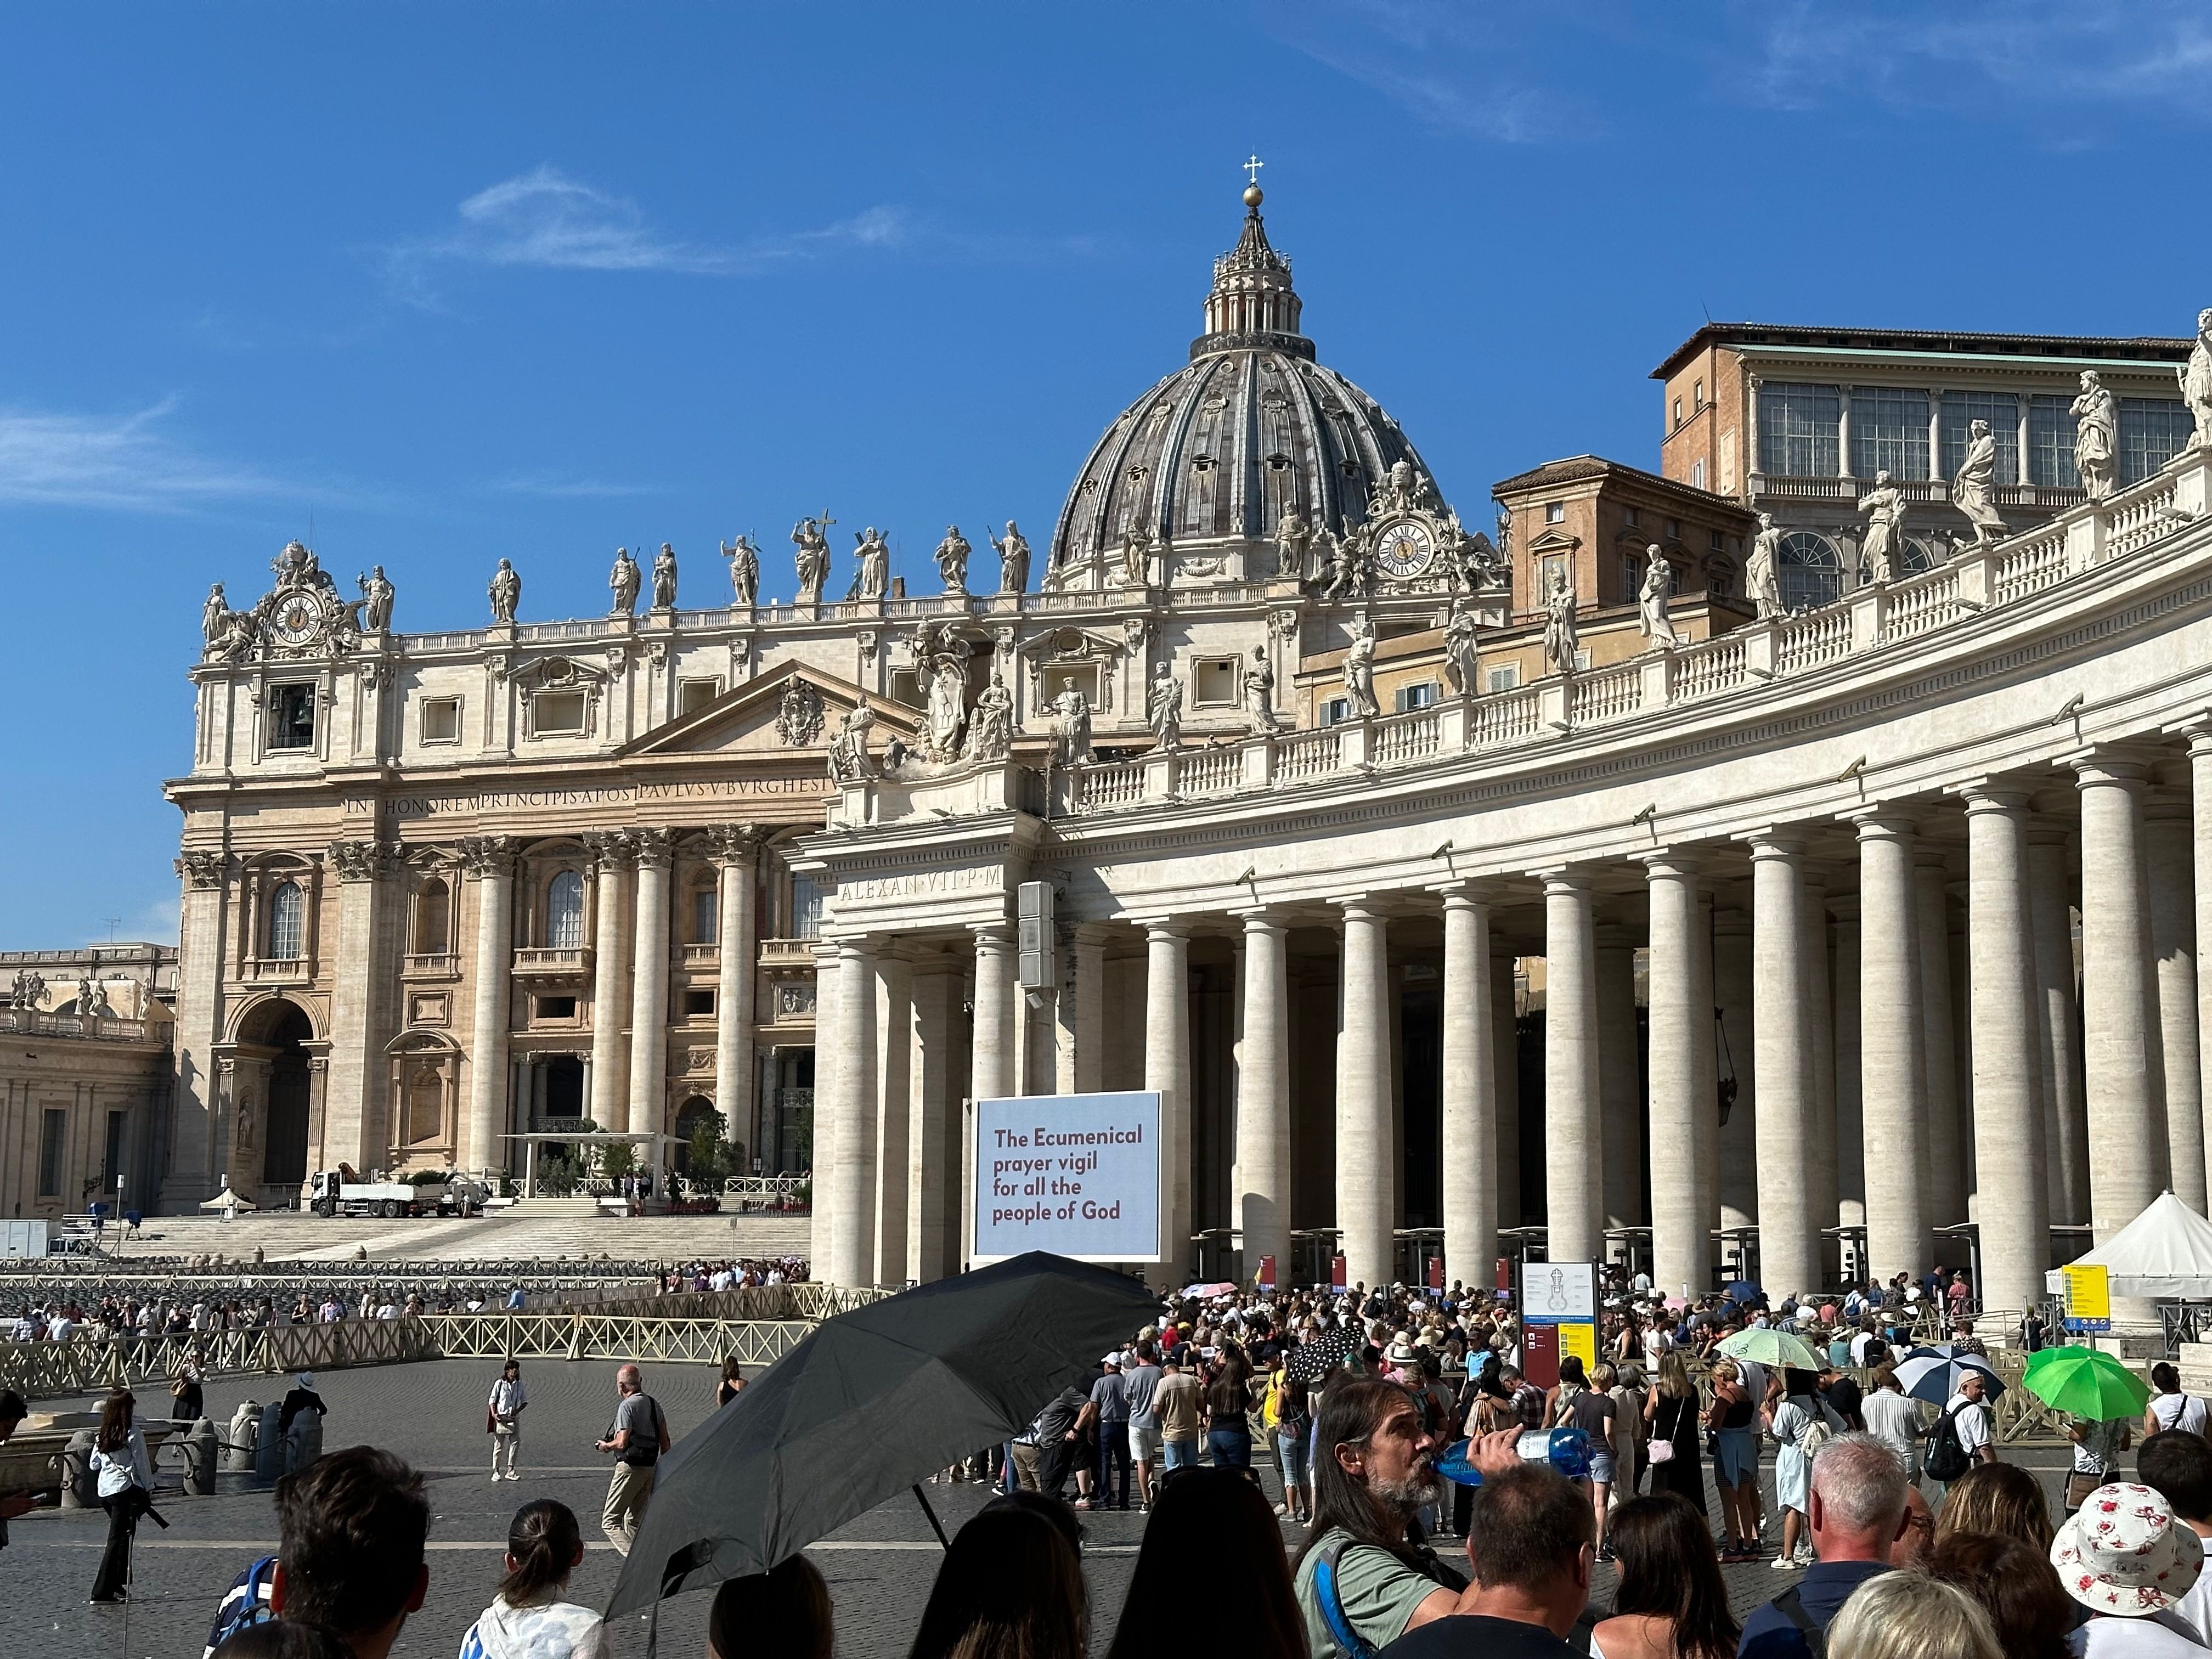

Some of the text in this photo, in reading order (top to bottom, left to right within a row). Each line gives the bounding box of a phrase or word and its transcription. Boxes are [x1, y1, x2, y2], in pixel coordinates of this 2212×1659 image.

[346, 798, 368, 814] IN
[385, 797, 480, 815] HONOREM
[481, 789, 577, 809] PRINCIPIS
[639, 781, 705, 799] PAVLVS
[709, 781, 721, 796] V
[840, 864, 1001, 901] ALEXAN VII P M
[994, 1123, 1142, 1148] The Ecumenical
[994, 1150, 1097, 1178] prayer vigil
[993, 1176, 1082, 1197] for all the
[992, 1200, 1120, 1226] people of God
